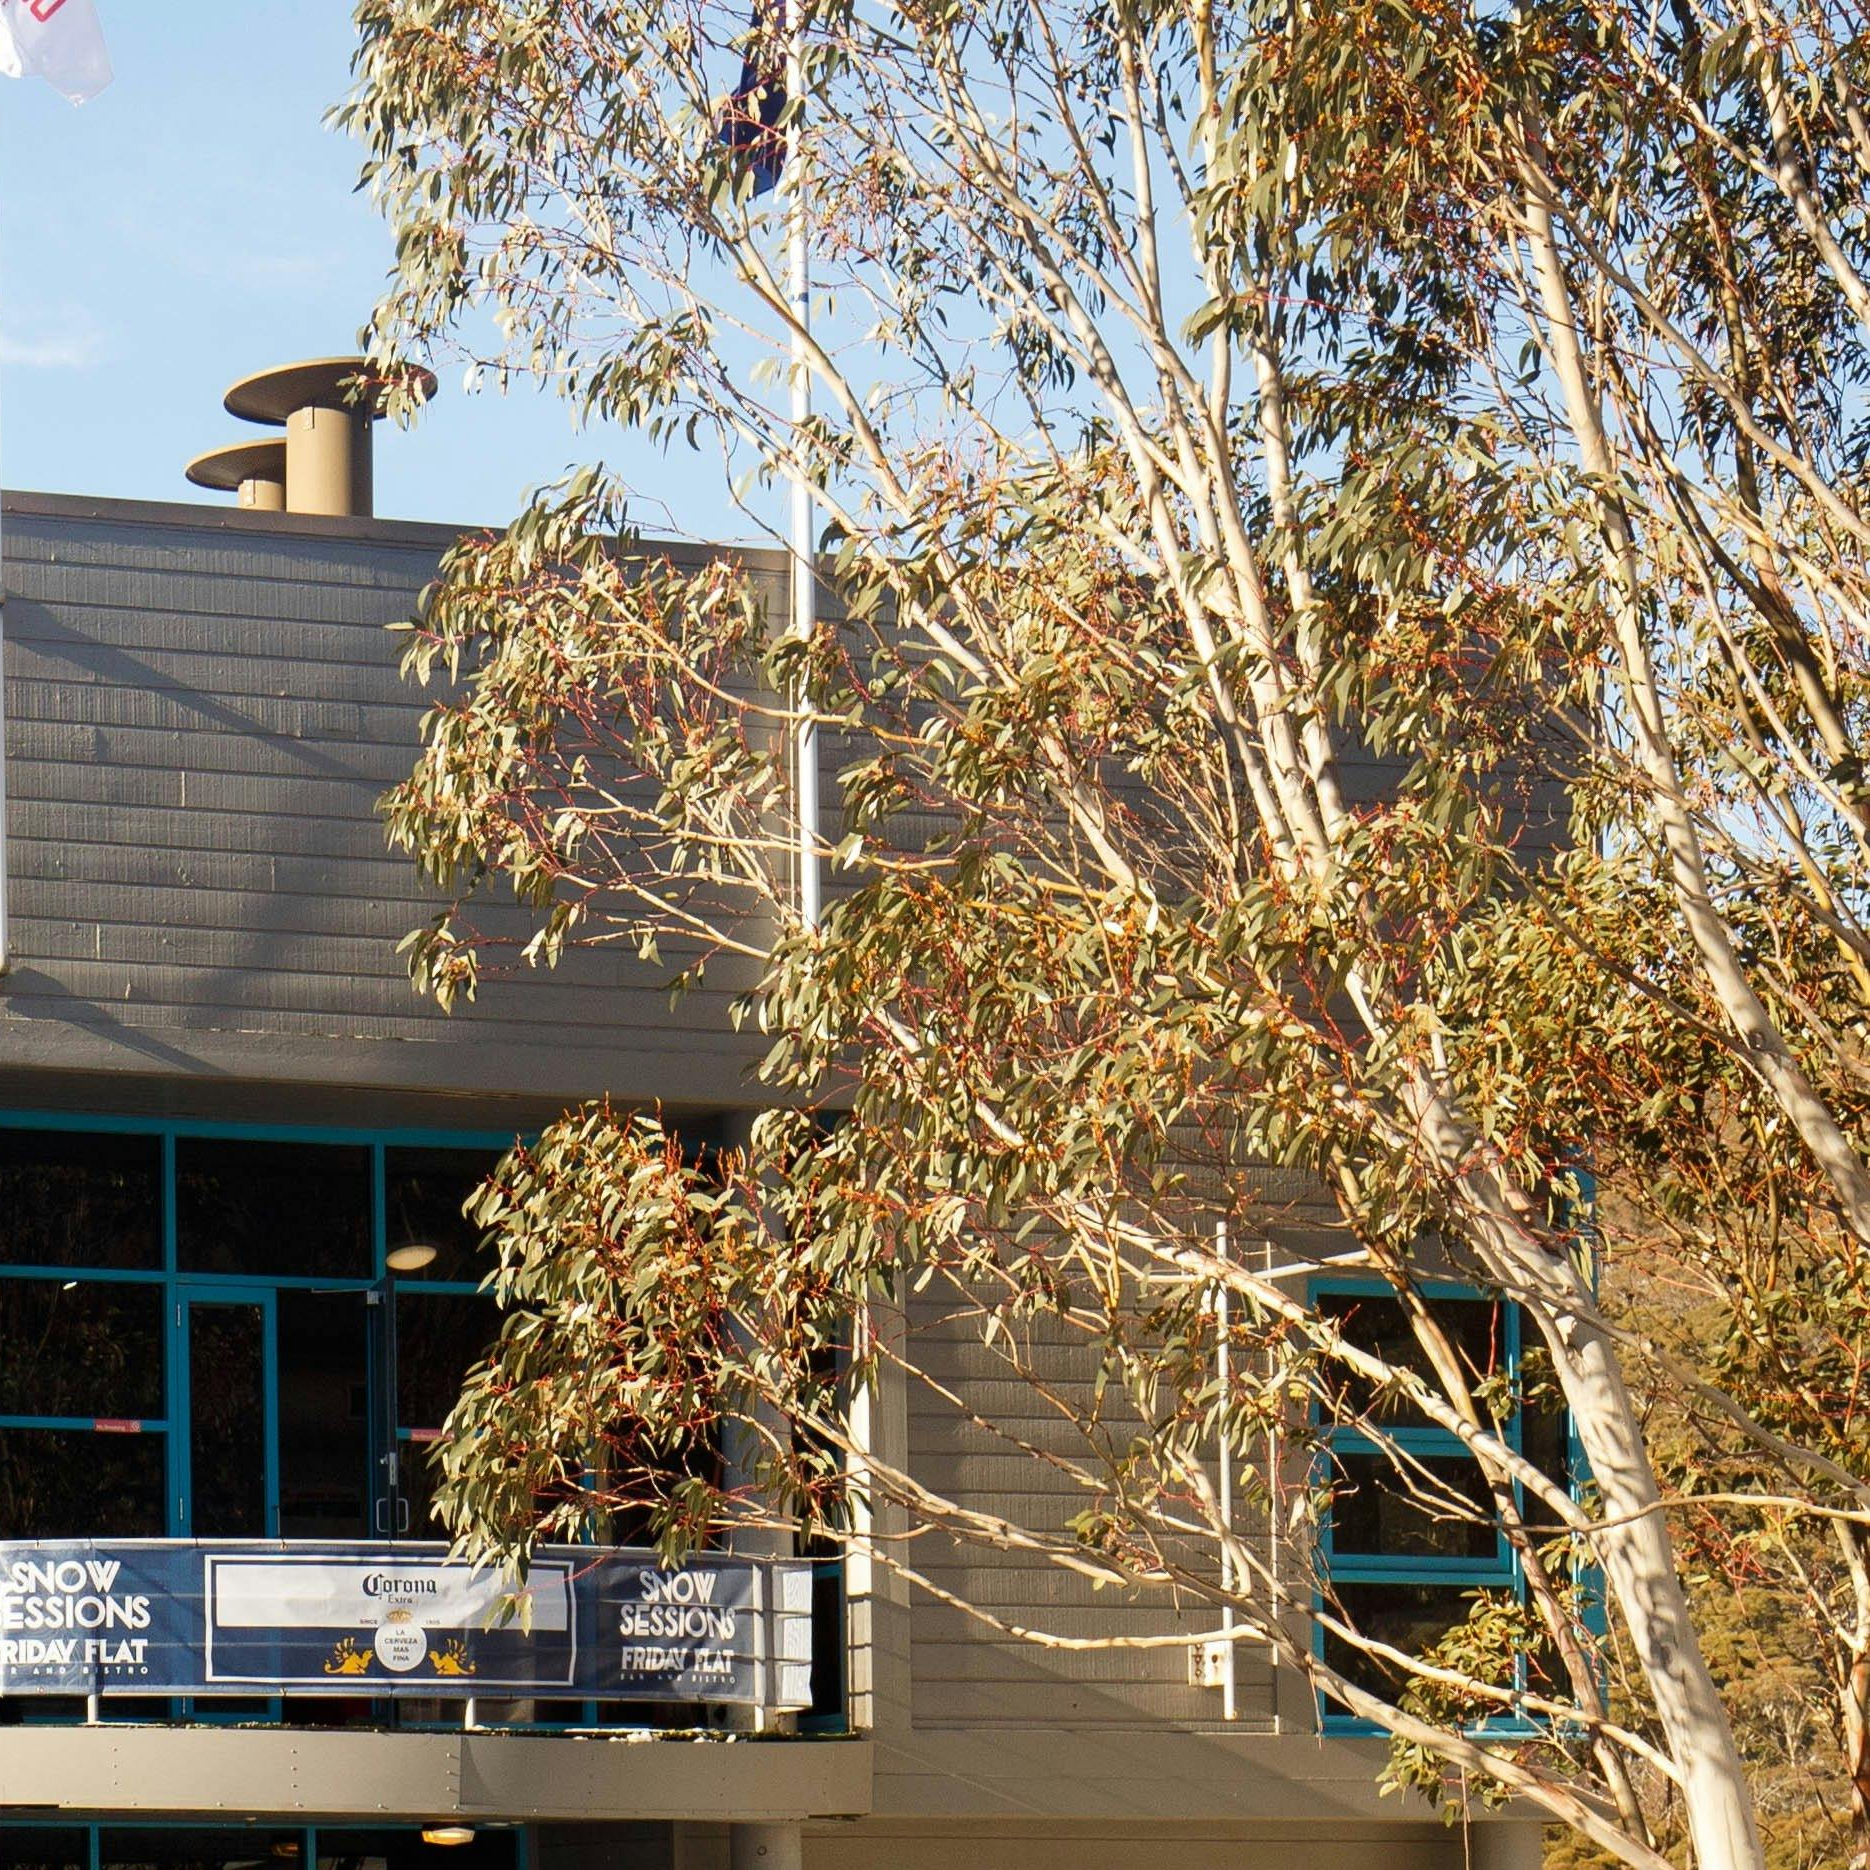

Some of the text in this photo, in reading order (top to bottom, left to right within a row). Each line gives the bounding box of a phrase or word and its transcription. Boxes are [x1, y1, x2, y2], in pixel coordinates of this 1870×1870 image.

[11, 1560, 121, 1595] SNOW
[363, 1573, 437, 1599] Corona
[639, 1571, 717, 1604] SNOW
[388, 1594, 413, 1604] Extra
[619, 1604, 736, 1640] SESSIONS
[85, 1638, 148, 1664] FLAT
[621, 1646, 735, 1673] FRIDAY FLAT
[33, 1666, 66, 1675] AND
[83, 1666, 149, 1675] BISTRO
[692, 1674, 736, 1685] BISTRO
